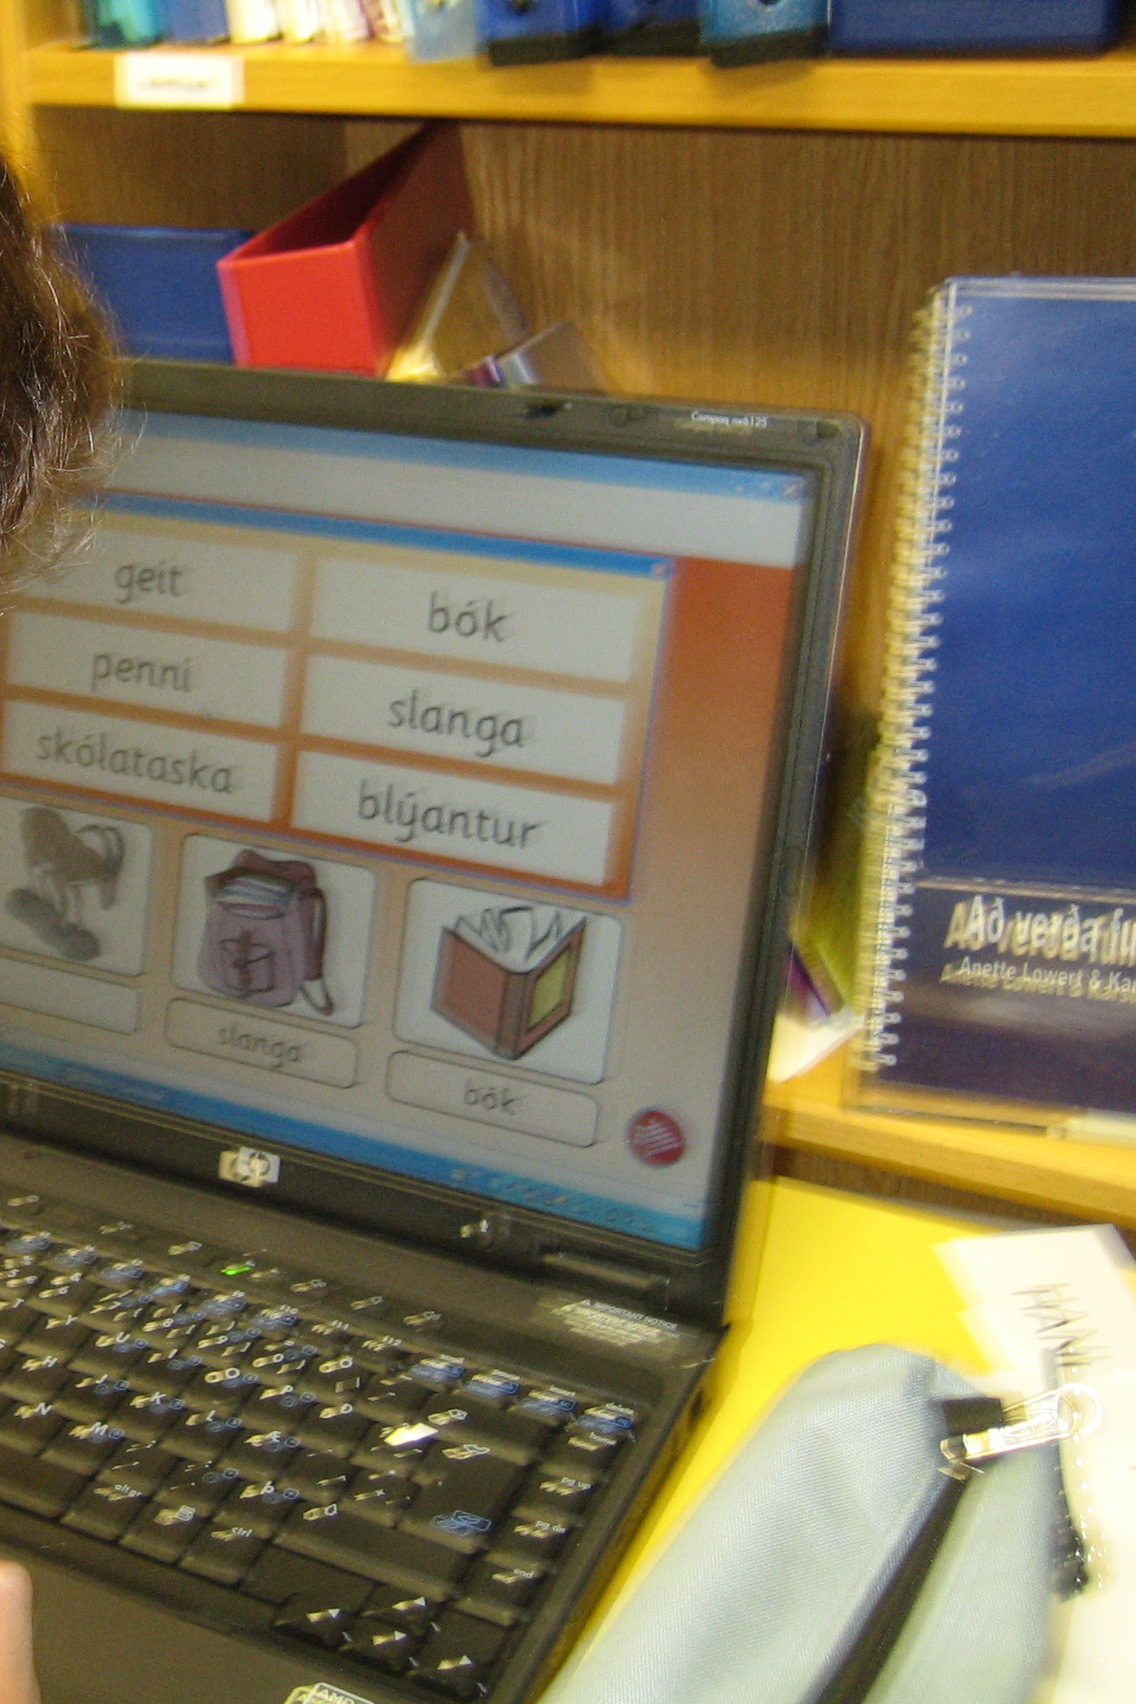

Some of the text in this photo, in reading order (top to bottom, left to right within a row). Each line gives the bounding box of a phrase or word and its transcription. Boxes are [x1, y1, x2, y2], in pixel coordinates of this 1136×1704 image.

[115, 557, 182, 604] geit
[428, 591, 513, 642] bók
[91, 649, 191, 693] penni
[387, 690, 525, 758] slanga
[37, 725, 232, 795] skólataska
[359, 780, 544, 849] blýantur
[216, 1022, 302, 1068] slanga
[464, 1079, 517, 1115] bók
